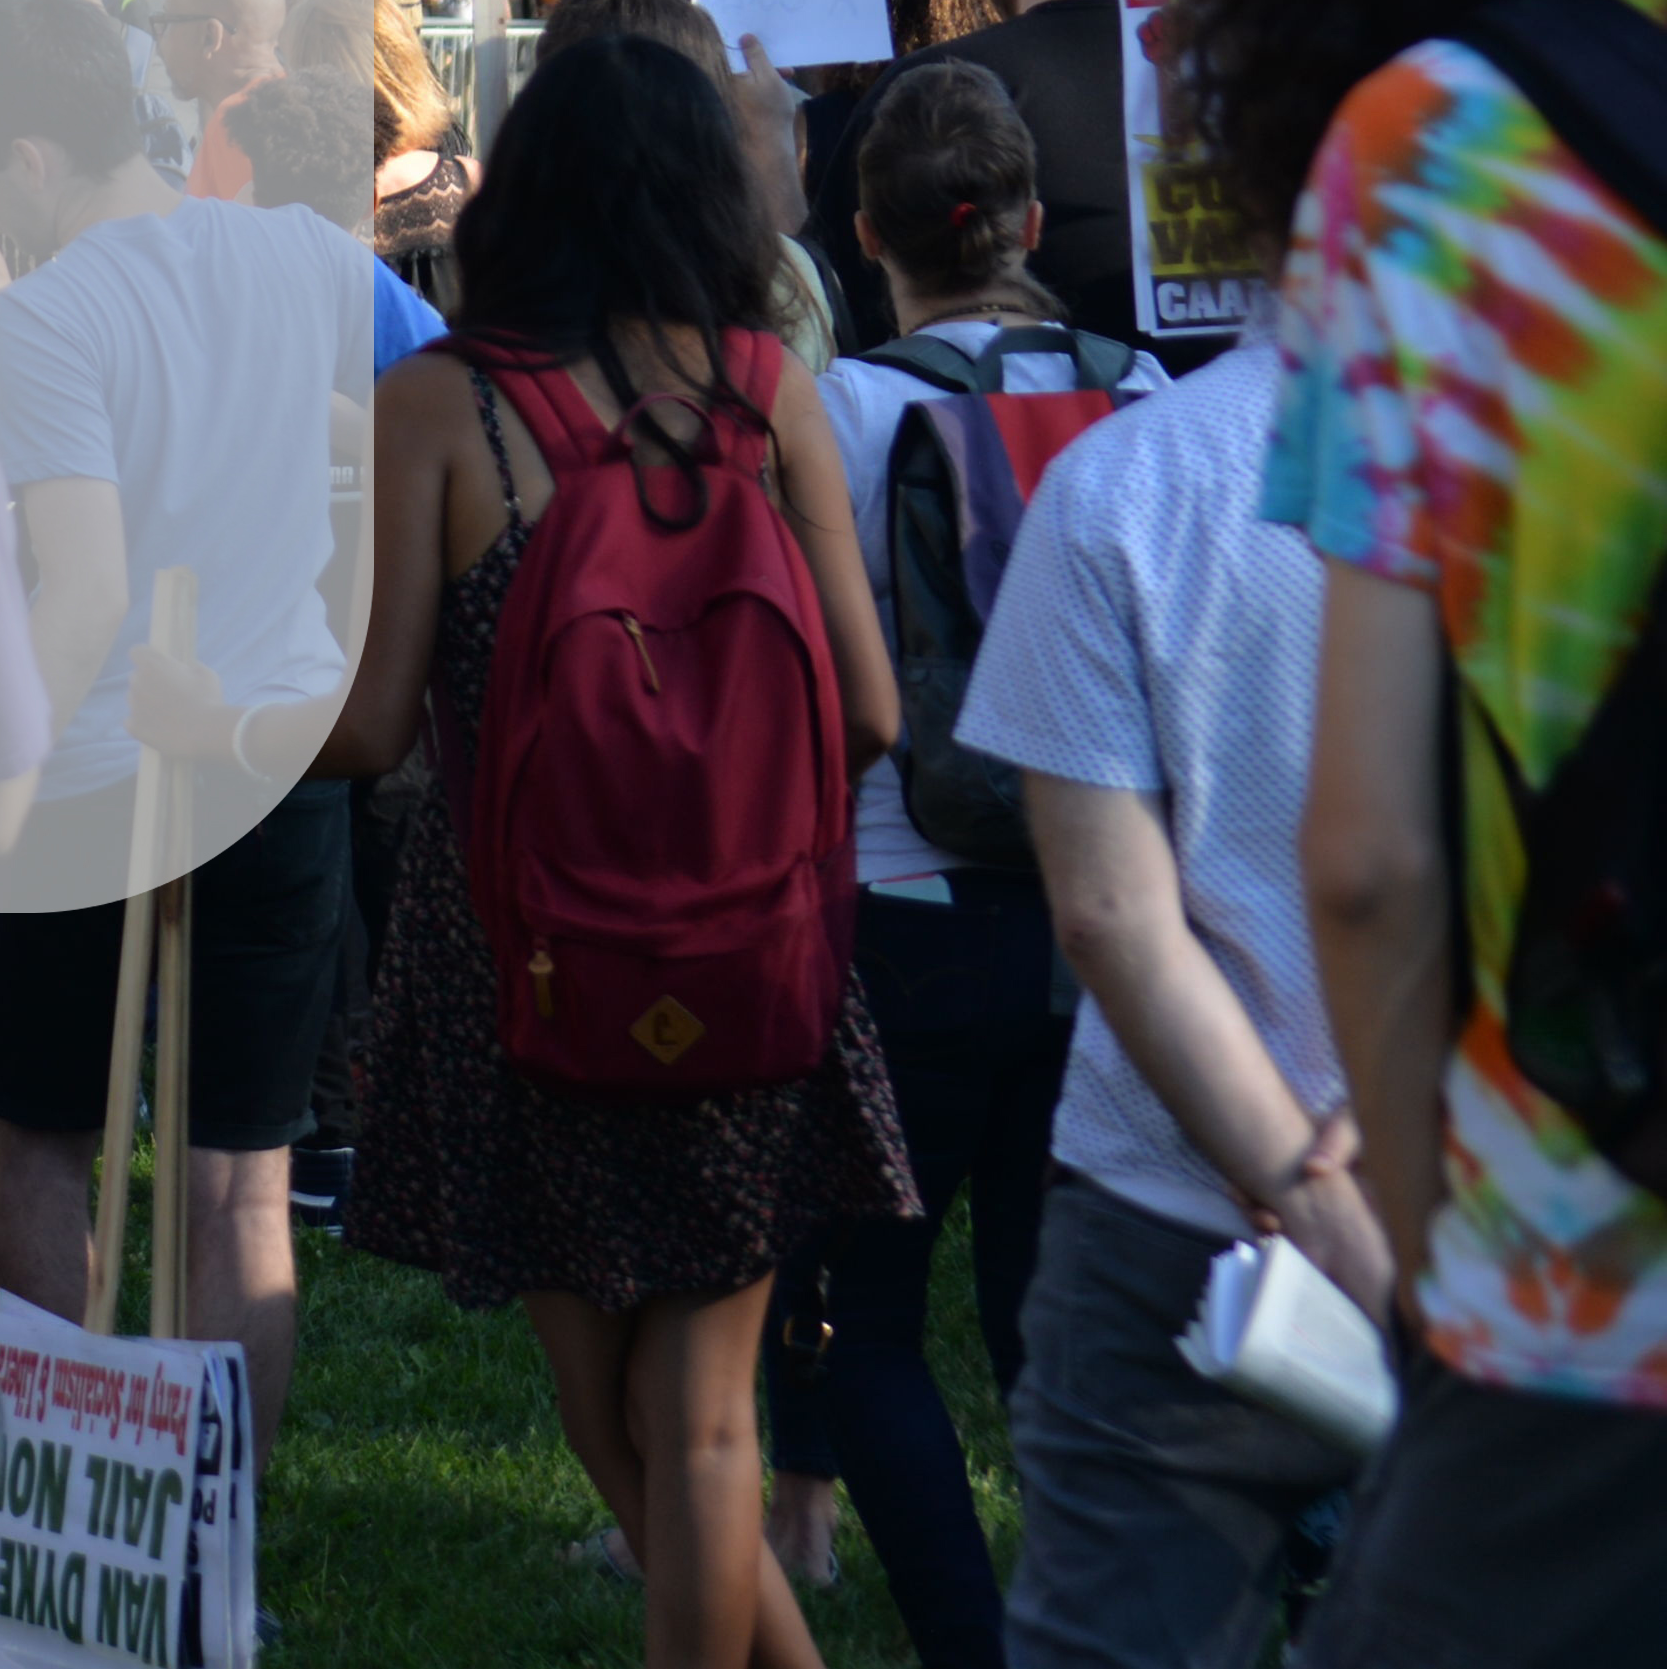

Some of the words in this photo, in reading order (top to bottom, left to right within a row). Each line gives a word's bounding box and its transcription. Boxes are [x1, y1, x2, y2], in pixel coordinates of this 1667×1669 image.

[52, 1358, 125, 1440] Socialism
[125, 1373, 148, 1446] for
[148, 1360, 193, 1456] Party
[86, 1453, 183, 1560] JAIL
[96, 1563, 169, 1669] VAN
